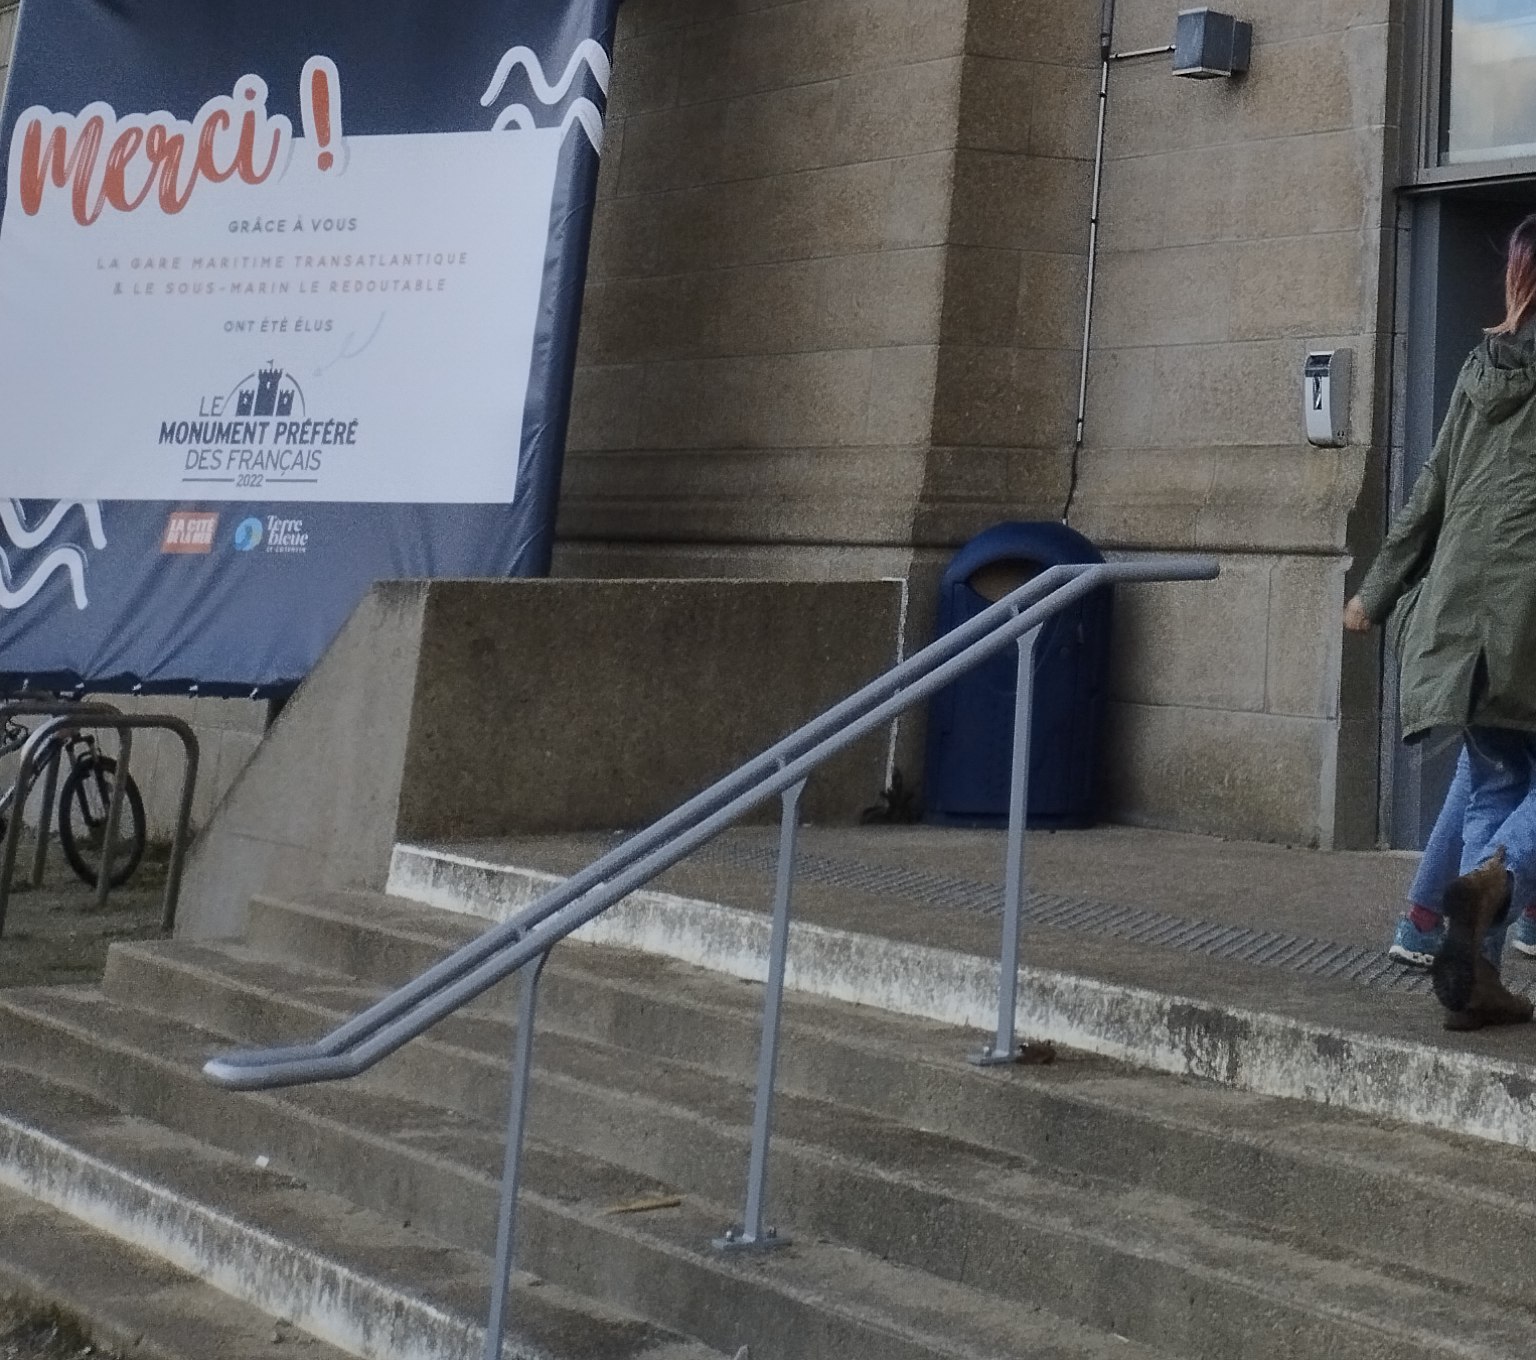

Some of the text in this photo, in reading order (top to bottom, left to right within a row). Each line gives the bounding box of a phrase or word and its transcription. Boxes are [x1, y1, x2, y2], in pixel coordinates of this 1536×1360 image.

[228, 216, 286, 233] GRÂCE
[311, 217, 358, 232] VOUS
[130, 256, 181, 270] GARE
[191, 255, 285, 269] MARITIME
[294, 251, 468, 268] TRANSATLANTIQUE
[133, 282, 155, 295] LE
[165, 281, 289, 295] SOUS-MARIN
[298, 280, 320, 294] LE
[329, 278, 446, 293] REDOUTABLE
[223, 315, 334, 332] ONT ÉTÉ ÉLUS
[199, 395, 224, 417] LE
[158, 417, 359, 445] MONUMENT PRÉFÉRÉ
[185, 449, 322, 476] DES FRANÇAIS
[236, 474, 264, 487] 2022
[267, 515, 303, 531] Terre
[268, 528, 309, 546] bleue
